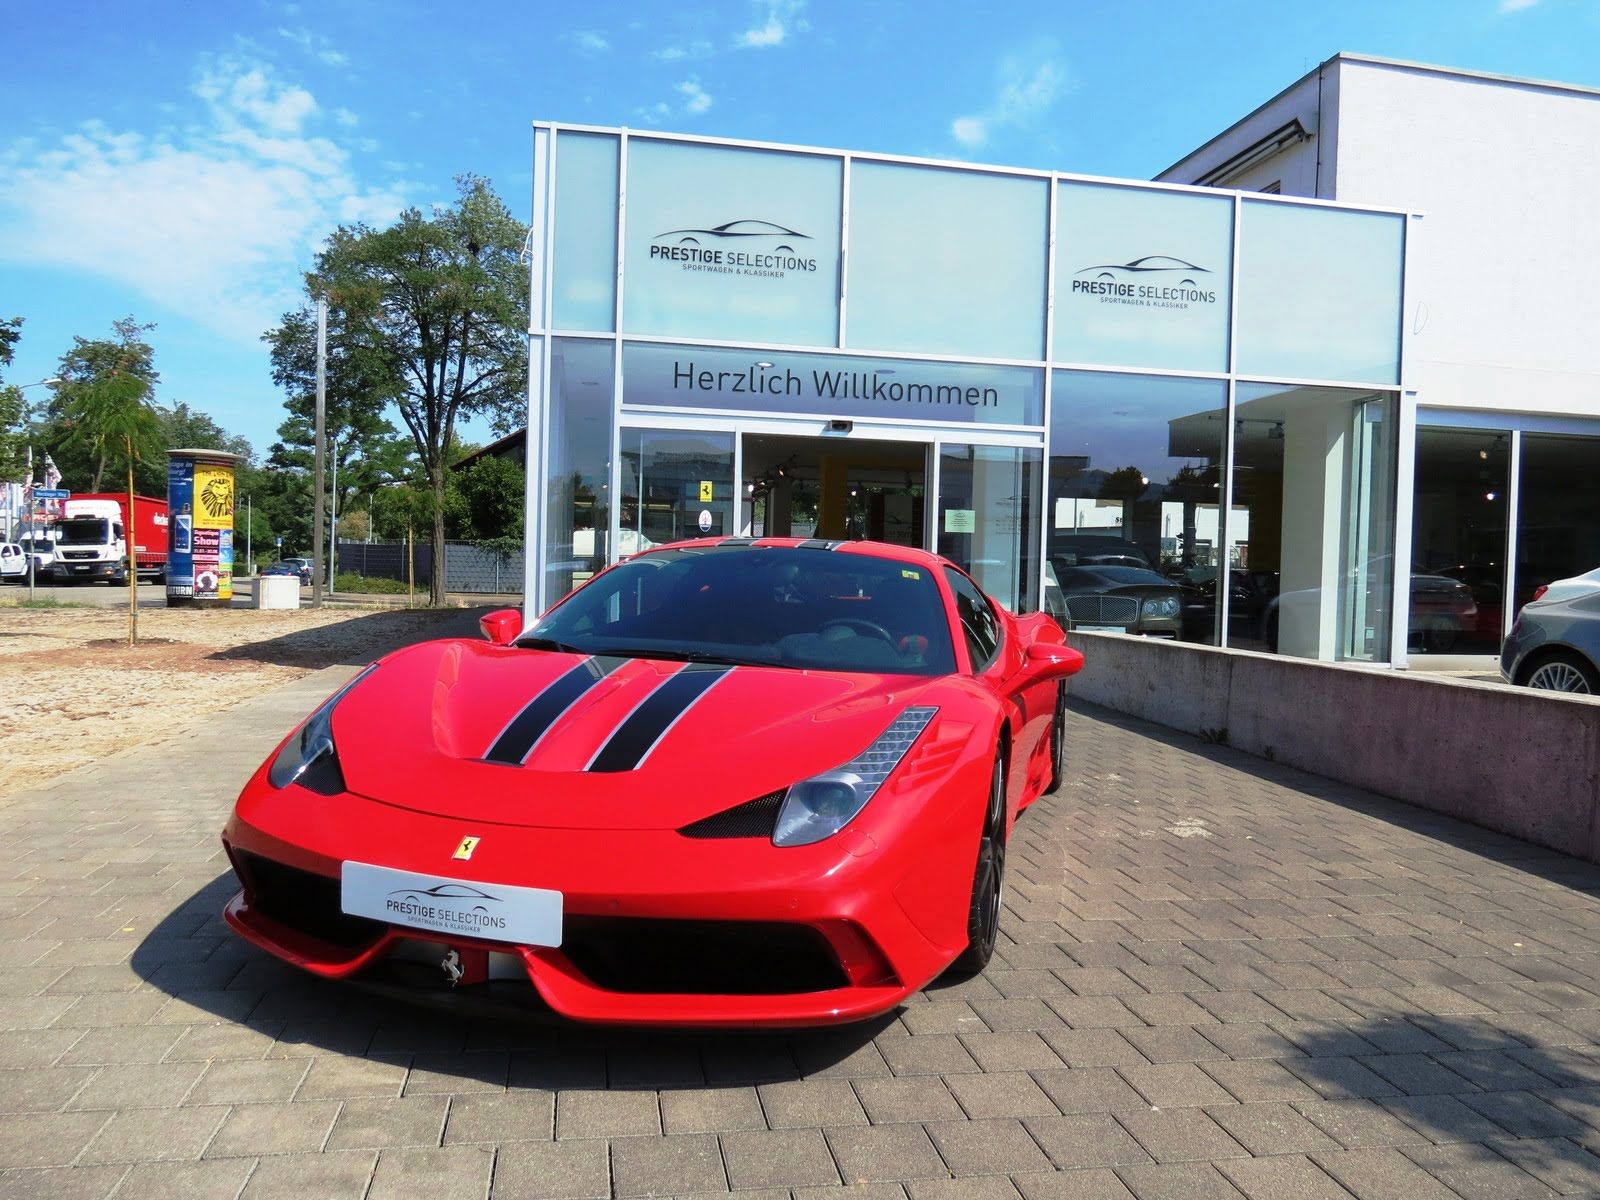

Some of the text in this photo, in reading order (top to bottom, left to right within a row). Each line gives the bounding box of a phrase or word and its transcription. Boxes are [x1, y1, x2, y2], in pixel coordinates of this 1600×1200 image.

[650, 245, 817, 272] PRESTIGE SELECTIONS
[682, 263, 734, 274] SPORTWAGEN
[743, 269, 785, 278] KLASSIKER
[1072, 280, 1216, 303] PRESTIGE SELECTIONS
[1100, 296, 1145, 306] SPORTWAGEN
[673, 361, 999, 407] Herzlich Willkommen
[193, 536, 219, 546] Show
[386, 900, 506, 929] PRESTIGE SELECTIONS
[407, 915, 443, 927] SPORTWAGEN
[450, 923, 481, 933] KLASSIKER
